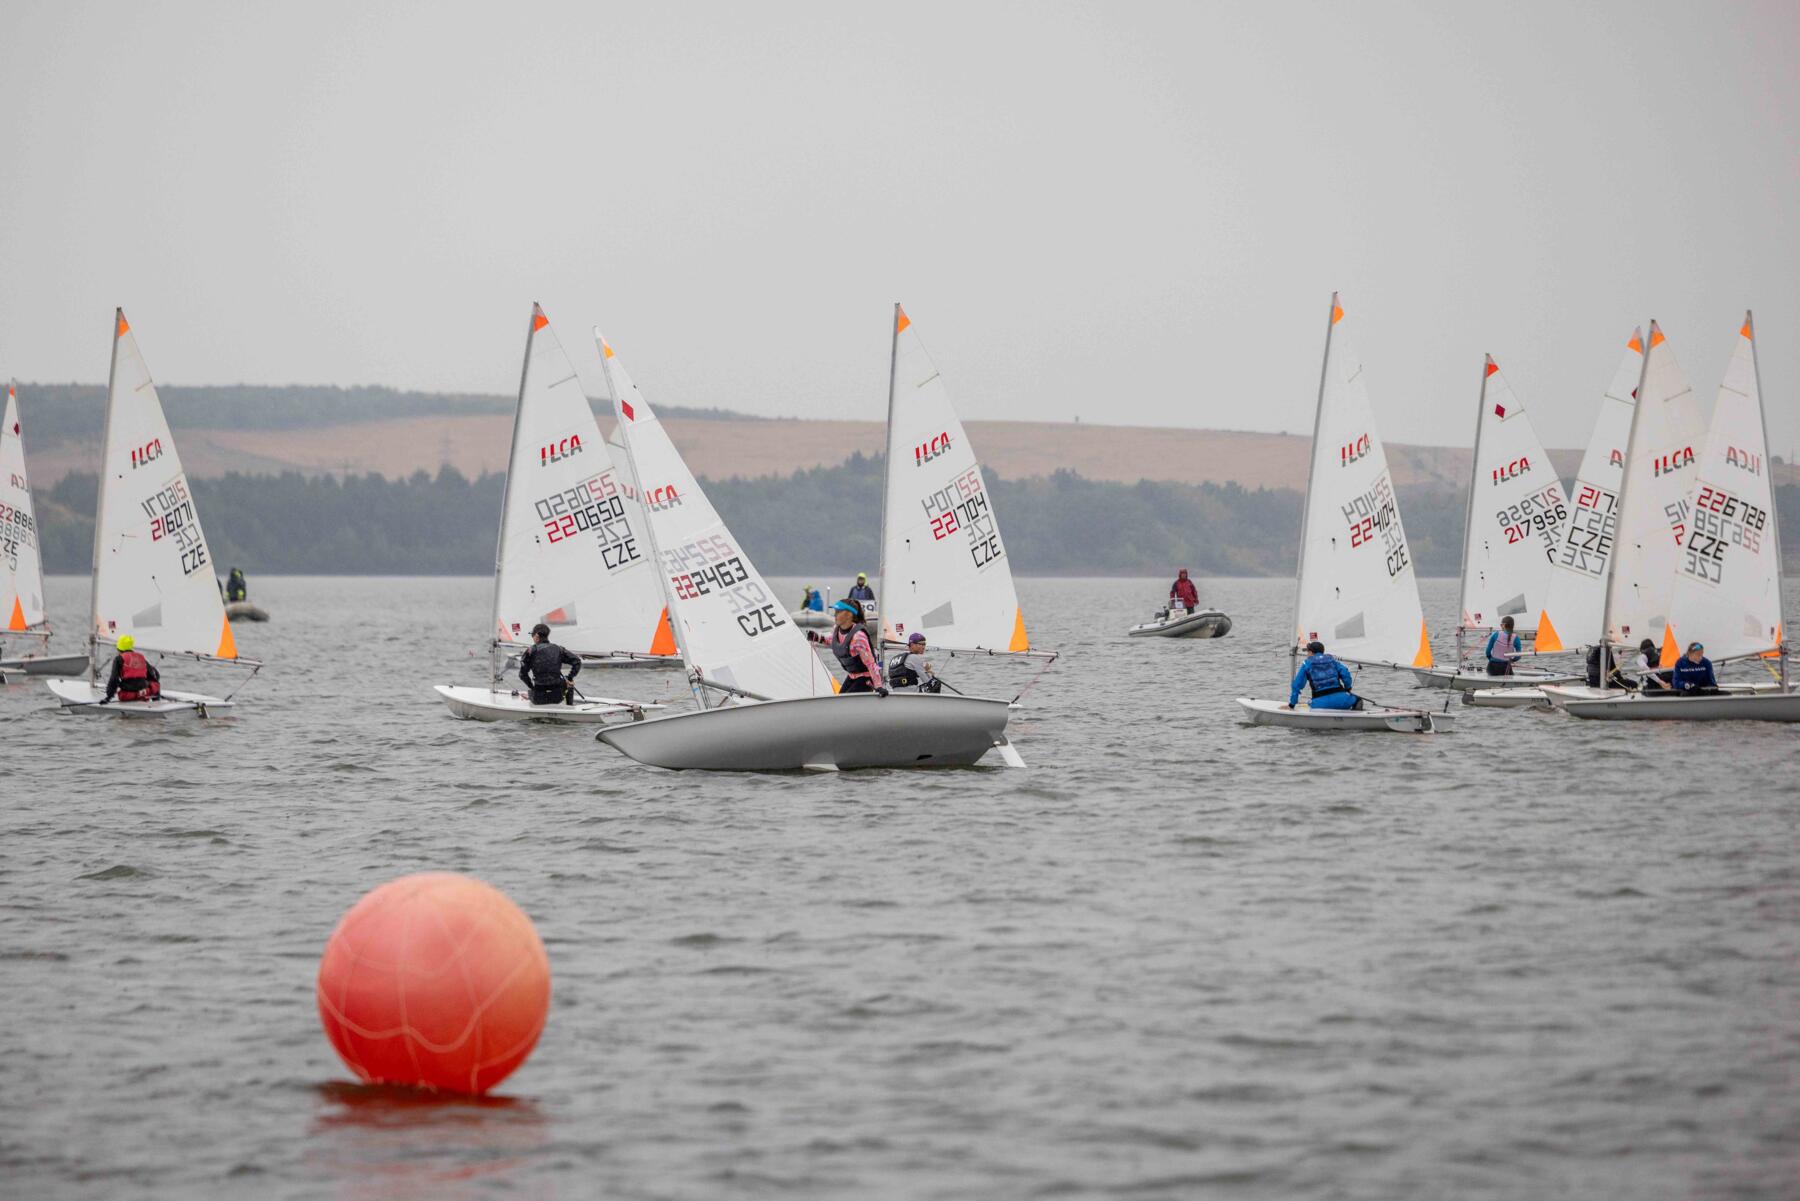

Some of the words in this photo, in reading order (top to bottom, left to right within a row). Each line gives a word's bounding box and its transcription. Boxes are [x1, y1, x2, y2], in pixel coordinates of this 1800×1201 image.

[131, 438, 163, 470] ILCA
[540, 434, 583, 467] ILCA
[914, 431, 951, 467] ILCA
[1341, 433, 1371, 468] ILCA
[1654, 446, 1695, 478] ILCA
[1492, 457, 1531, 486] ILCA
[150, 500, 193, 542] 216071
[543, 495, 625, 544] 220650
[930, 491, 988, 541] 221704
[1350, 498, 1396, 548] 224104
[1504, 504, 1567, 544] 217956
[1697, 486, 1766, 531] 226728
[0, 536, 19, 557] ZE
[601, 538, 641, 570] CZE
[970, 534, 1001, 568] CZE
[1567, 526, 1613, 556] CZE
[1687, 531, 1729, 561] CZE
[181, 543, 206, 576] CZE
[1386, 543, 1408, 577] CZE
[671, 557, 749, 600] 222463
[737, 604, 786, 637] CZE
